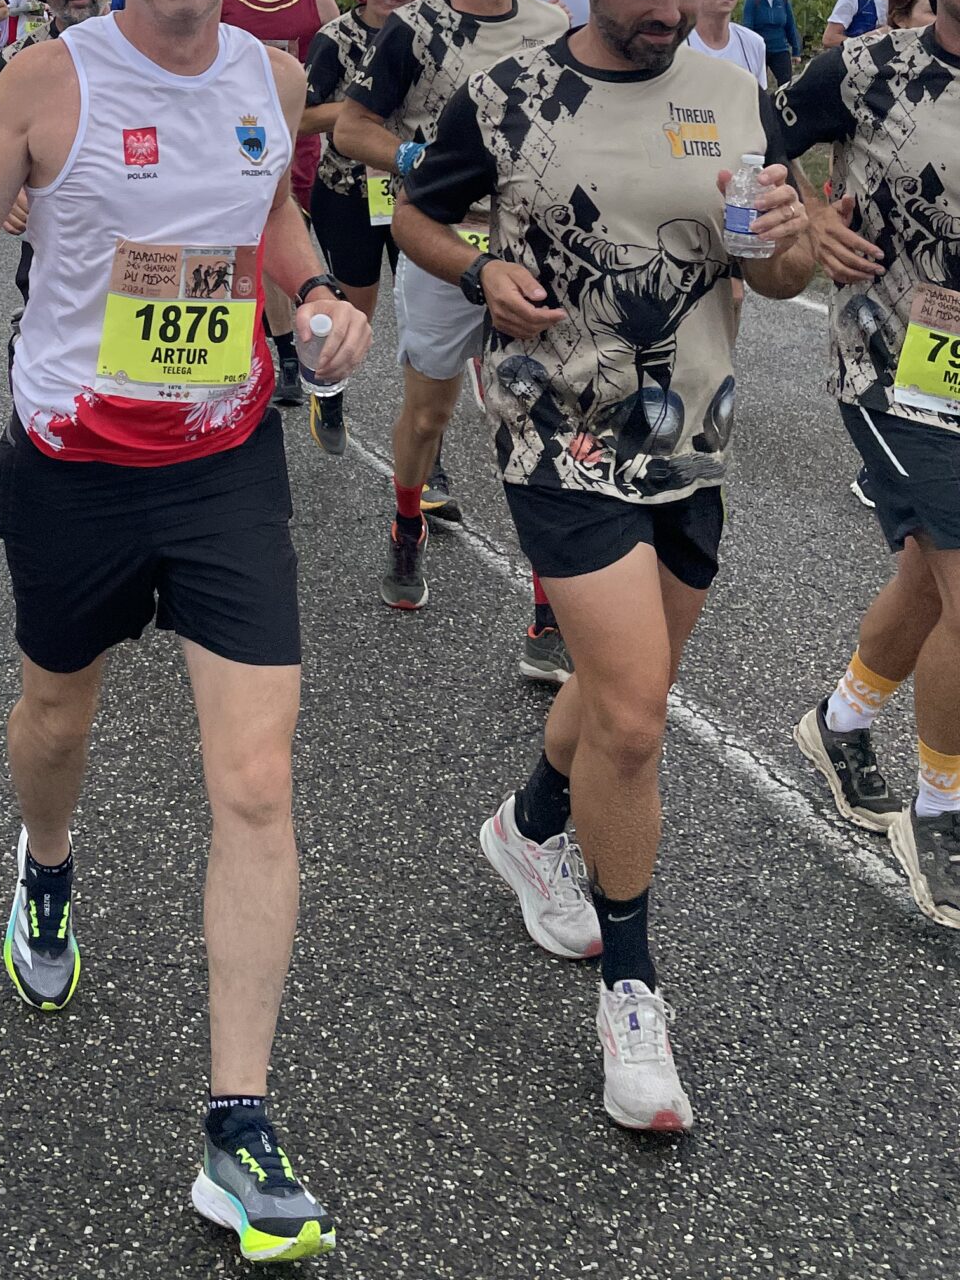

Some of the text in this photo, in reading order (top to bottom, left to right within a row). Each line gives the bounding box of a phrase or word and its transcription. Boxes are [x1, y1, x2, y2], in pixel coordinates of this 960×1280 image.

[674, 107, 716, 124] TIREUR
[683, 140, 721, 157] LITRES
[127, 172, 158, 180] POLSKA
[128, 249, 178, 263] MARATHON
[124, 270, 138, 282] DU
[121, 283, 144, 295] 2024
[135, 303, 230, 344] 1876
[151, 347, 208, 365] ARTUR
[162, 366, 192, 375] TELEGA
[224, 374, 237, 383] POL
